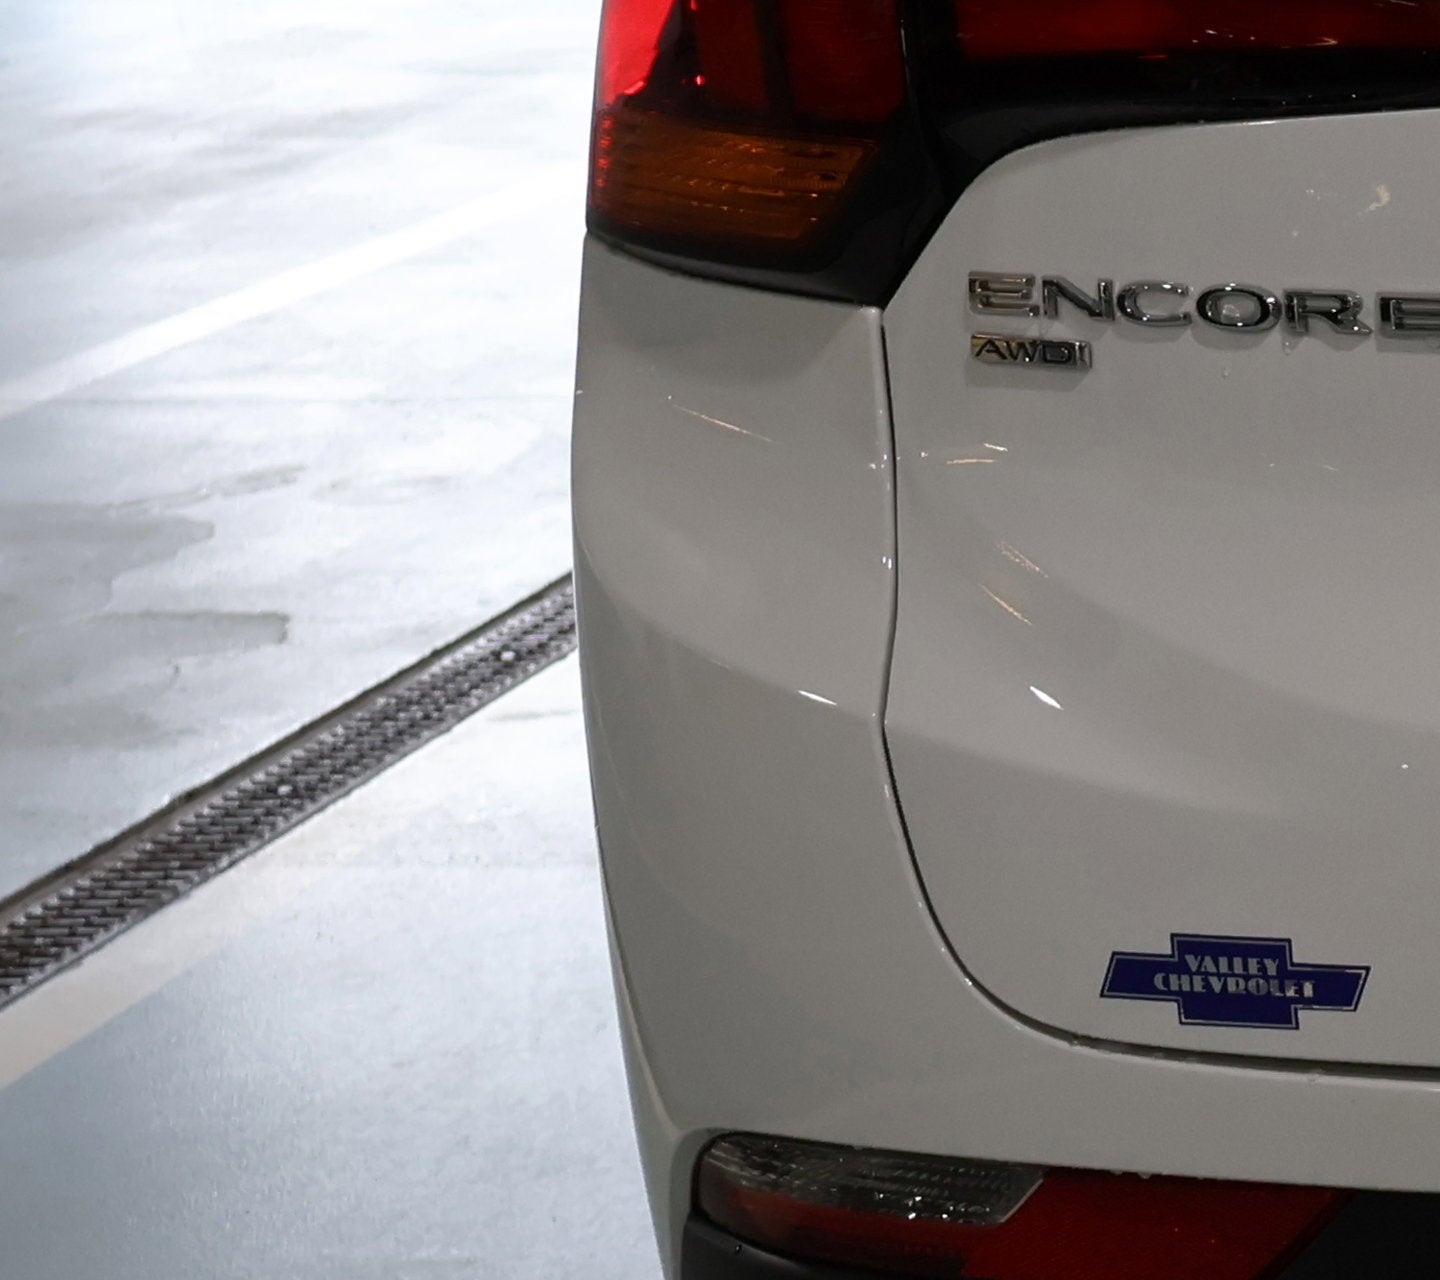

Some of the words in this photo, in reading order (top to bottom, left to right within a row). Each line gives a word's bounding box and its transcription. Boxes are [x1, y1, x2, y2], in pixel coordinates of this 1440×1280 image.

[973, 336, 1080, 366] AWD
[1184, 953, 1280, 977] VALLEY
[1153, 972, 1316, 998] CHEVROLET
